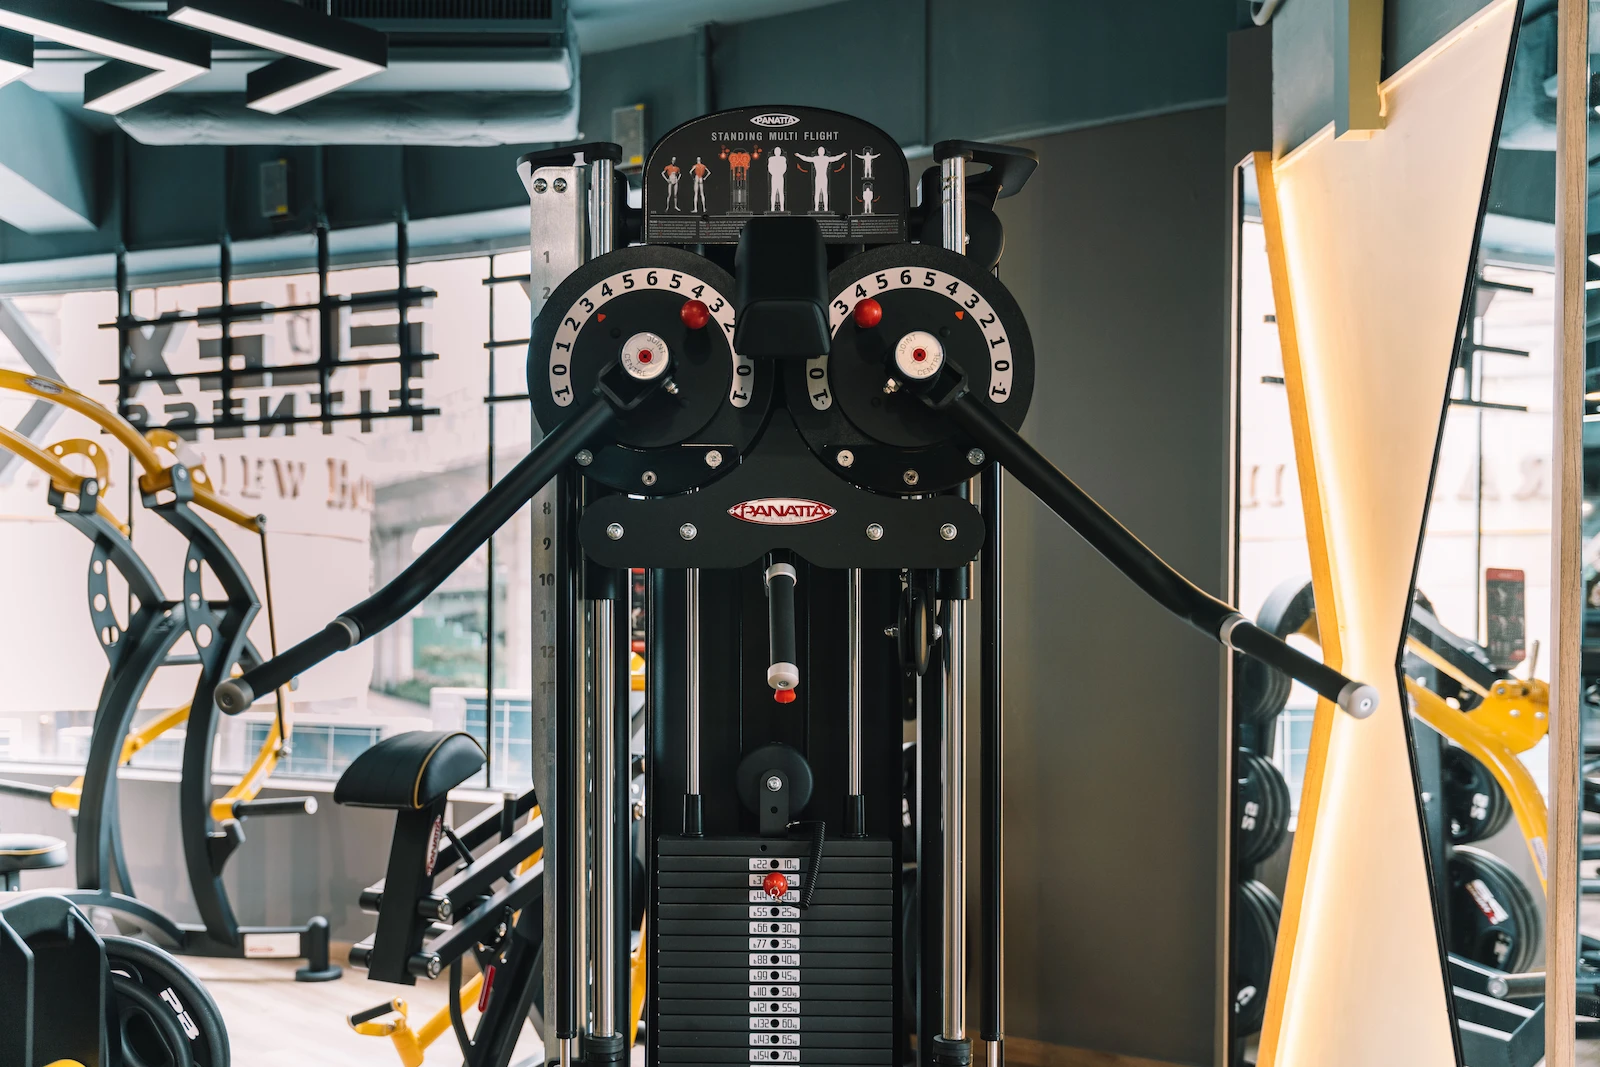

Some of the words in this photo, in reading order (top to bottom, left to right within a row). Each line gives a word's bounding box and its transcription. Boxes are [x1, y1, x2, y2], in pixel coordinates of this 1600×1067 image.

[755, 116, 796, 125] PANATTA
[711, 132, 762, 141] STANDING
[769, 132, 798, 140] MULTI
[804, 132, 839, 140] FLIGHT
[622, 273, 635, 290] 5
[646, 271, 658, 286] 6
[669, 273, 683, 290] 5
[876, 274, 888, 290] 5
[900, 270, 912, 285] 6
[923, 272, 937, 287] 5
[601, 283, 614, 298] 4
[691, 284, 706, 299] 4
[855, 284, 868, 298] 4
[946, 281, 960, 296] 4
[579, 298, 595, 314] 3
[708, 298, 724, 313] 3
[834, 300, 849, 316] 3
[964, 294, 980, 309] 3
[564, 317, 581, 332] 2
[980, 313, 996, 328] 2
[556, 342, 571, 352] 1
[646, 336, 666, 354] JOINT
[899, 334, 916, 354] JOINT
[990, 336, 1006, 349] 1
[552, 364, 568, 376] 0
[624, 354, 646, 376] CENTRE
[736, 364, 752, 377] 0
[917, 352, 941, 376] CENTRE
[994, 360, 1010, 372] 0
[809, 368, 824, 380] 0
[738, 503, 829, 520] PANATTA
